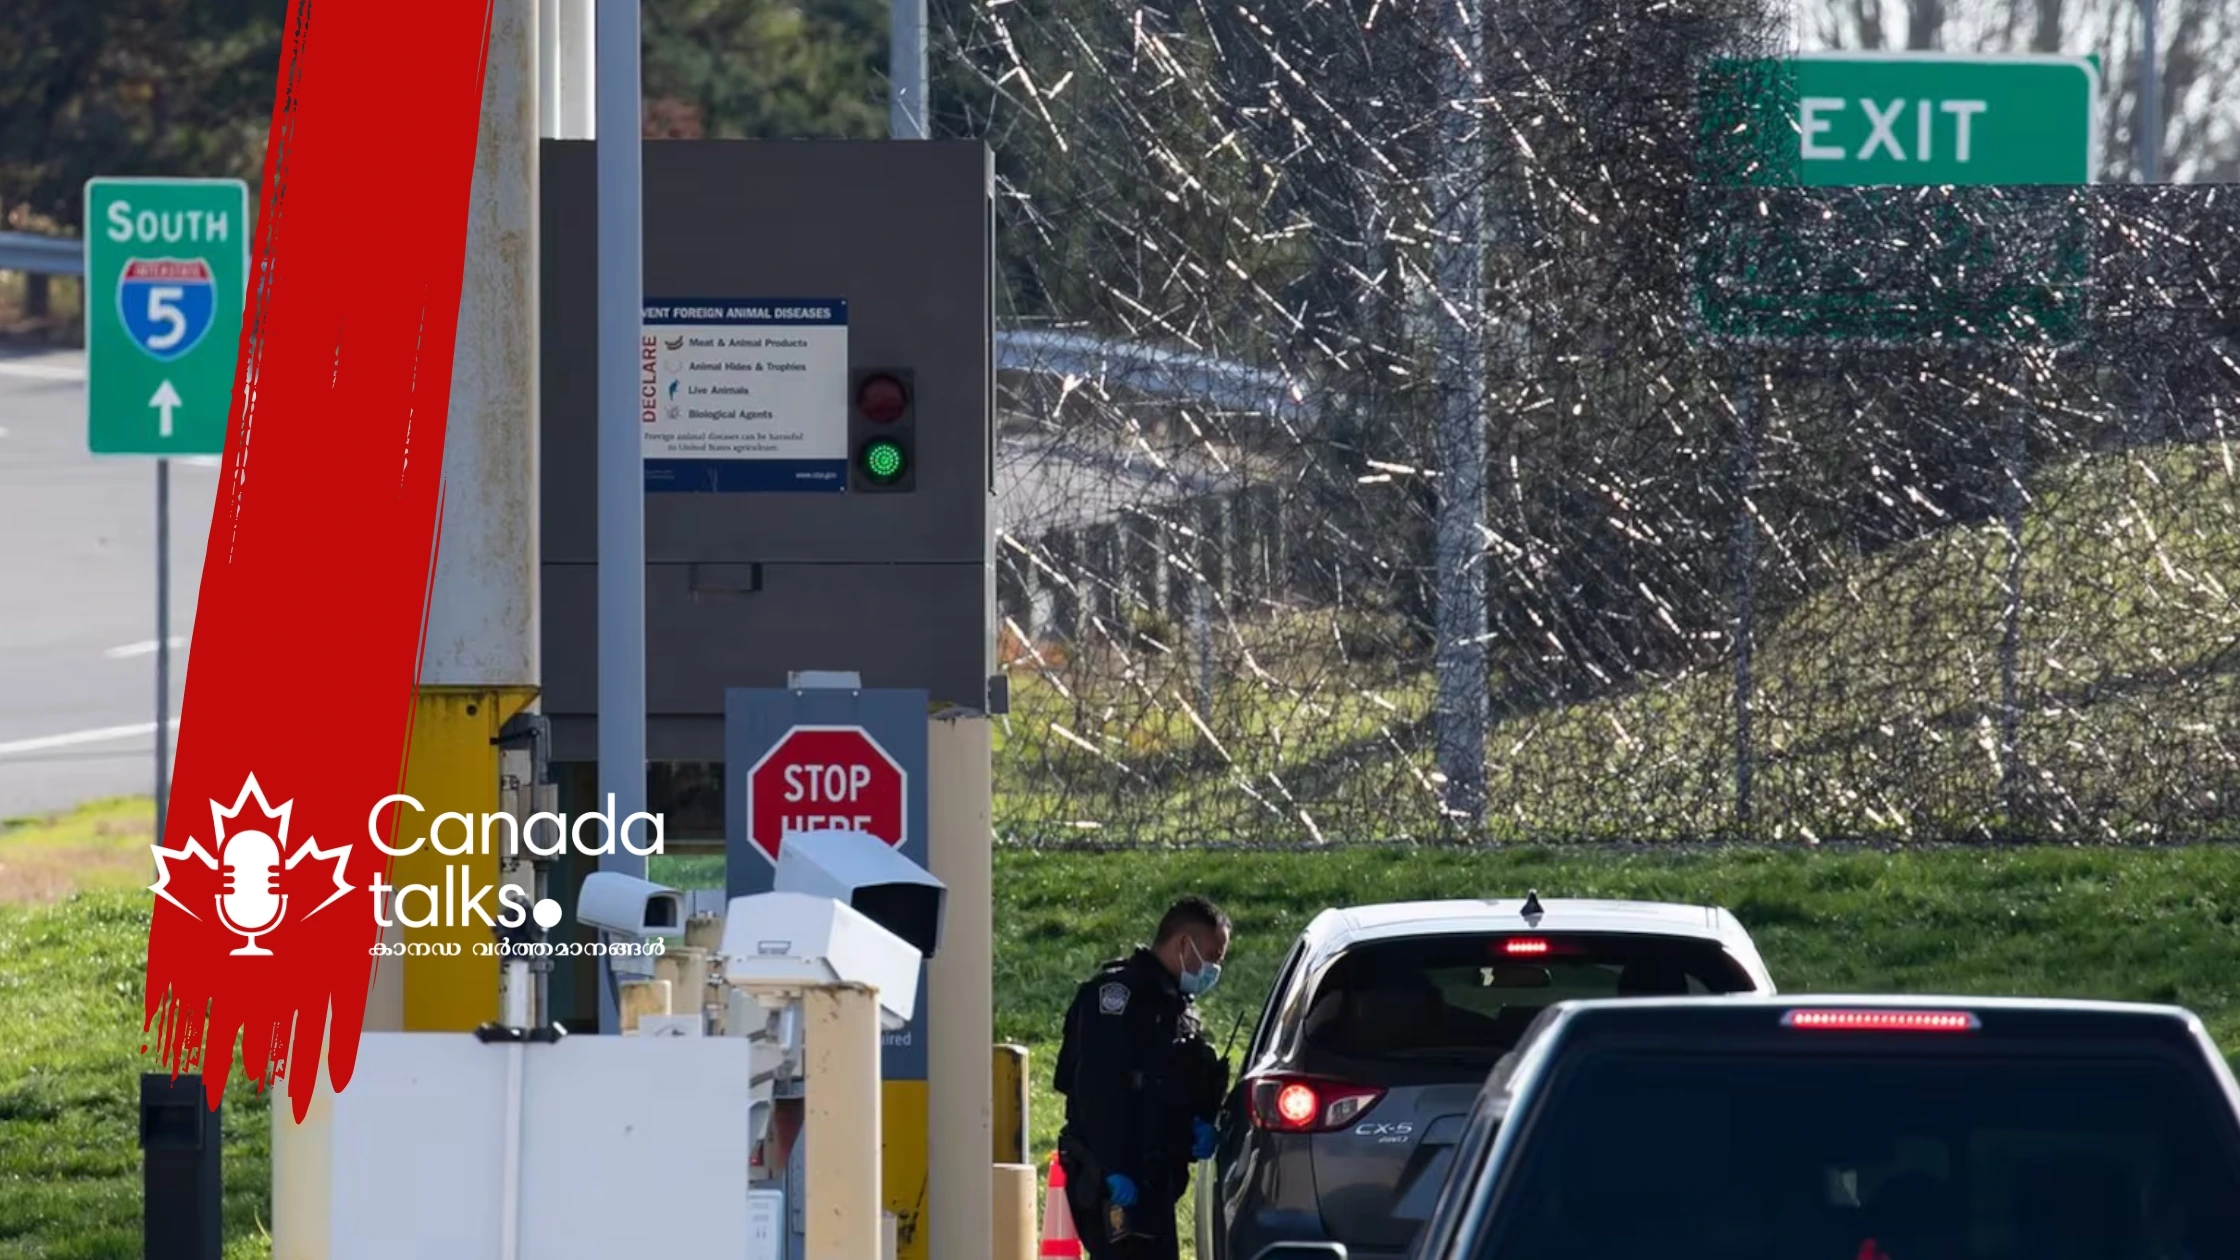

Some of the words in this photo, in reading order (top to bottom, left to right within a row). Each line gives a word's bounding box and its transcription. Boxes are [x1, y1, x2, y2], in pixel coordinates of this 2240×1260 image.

[1801, 98, 1987, 162] EXIT
[107, 201, 228, 242] SOUTH
[147, 286, 187, 350] 5
[673, 307, 724, 319] FOREIGN
[726, 307, 771, 319] ANIMAL
[774, 307, 831, 319] DISEASES
[689, 338, 714, 347] Meat
[717, 338, 725, 347] &
[729, 338, 761, 347] Animal
[765, 338, 808, 347] Products
[689, 362, 722, 371] Animal
[725, 362, 752, 371] Hides
[755, 362, 763, 371] &
[767, 362, 806, 373] Trophies
[642, 335, 656, 423] DECLARE
[688, 385, 707, 395] Live
[711, 385, 749, 395] Animals
[688, 409, 736, 421] Biological
[739, 409, 773, 420] Agents
[784, 764, 871, 802] STOP
[1355, 1122, 1414, 1135] CX-5
